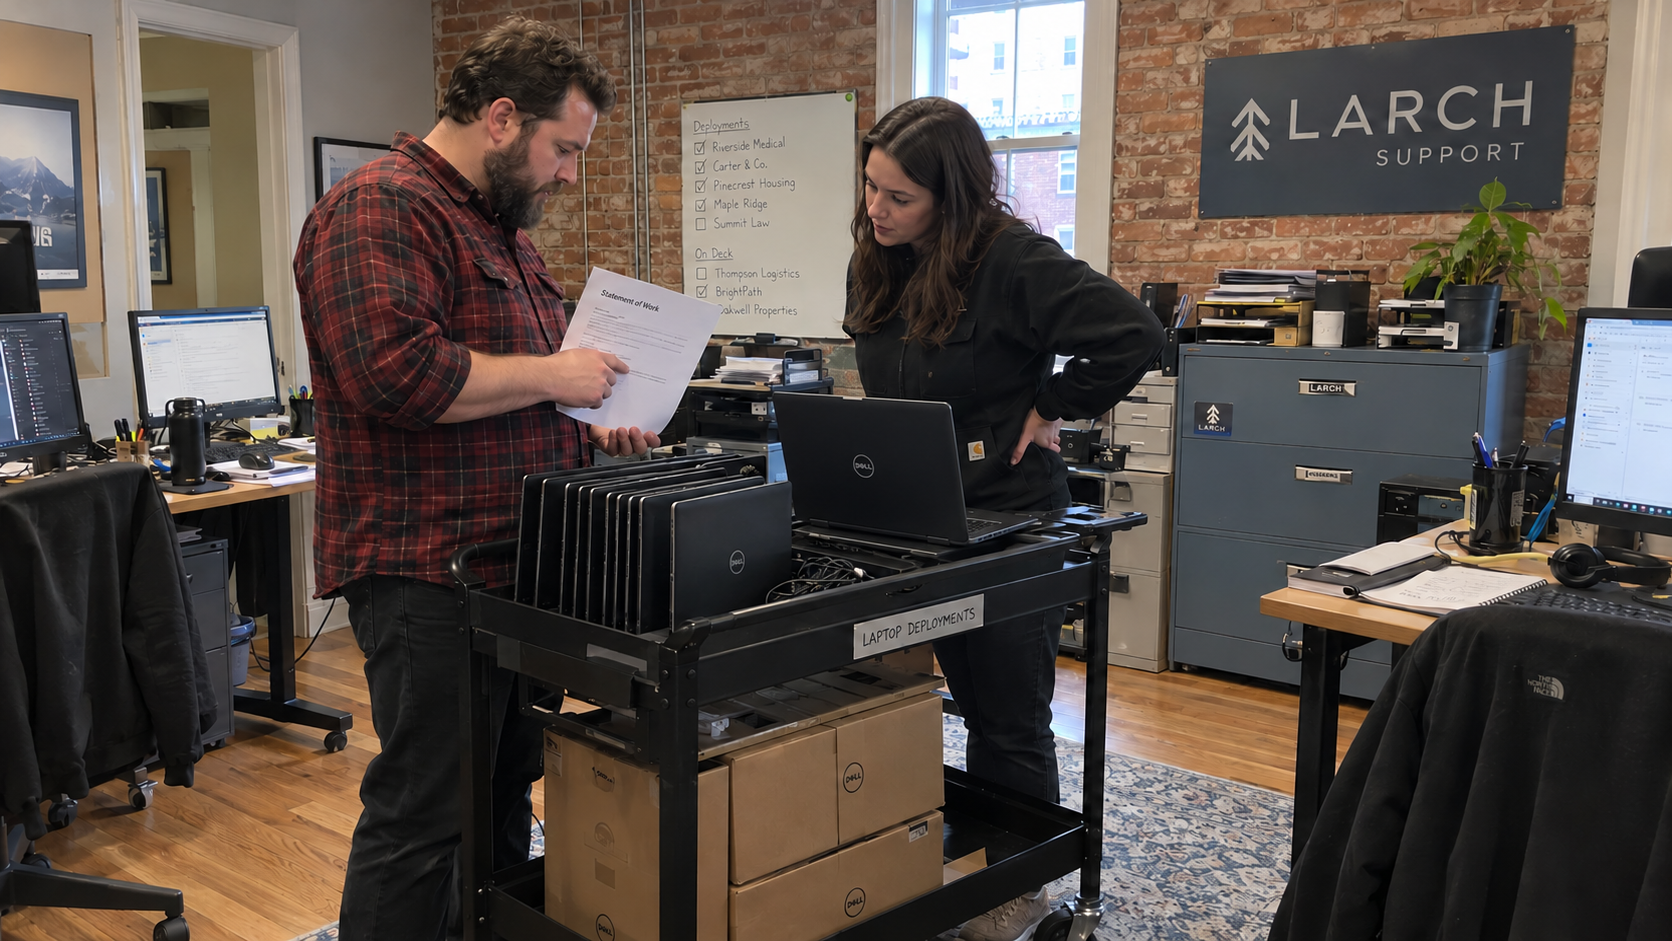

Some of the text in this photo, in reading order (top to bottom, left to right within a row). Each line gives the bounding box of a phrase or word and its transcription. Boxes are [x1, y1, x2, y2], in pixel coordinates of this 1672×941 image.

[1289, 80, 1533, 140] LARCH
[693, 118, 750, 135] Deployments
[712, 136, 786, 153] Riverside Medical
[1376, 142, 1524, 166] SUPPORT
[713, 158, 768, 172] Carter & Co.
[713, 178, 796, 192] Pinecrest Housing
[713, 198, 768, 212] Maple Ridge
[713, 217, 770, 229] Summit Law
[695, 248, 733, 259] On Deck
[715, 268, 800, 282] Thompson Logistics
[716, 286, 763, 300] BrightPath
[601, 289, 634, 305] Statement
[642, 302, 660, 312] Work
[754, 304, 798, 318] Properties
[1310, 384, 1342, 392] LARCH
[1198, 424, 1226, 432] LARCH
[855, 462, 873, 470] DELL
[862, 607, 976, 647] LAPTOP DEPLOYMENTS
[1538, 674, 1551, 683] THE
[846, 772, 861, 784] DELL
[847, 896, 863, 909] DELL
